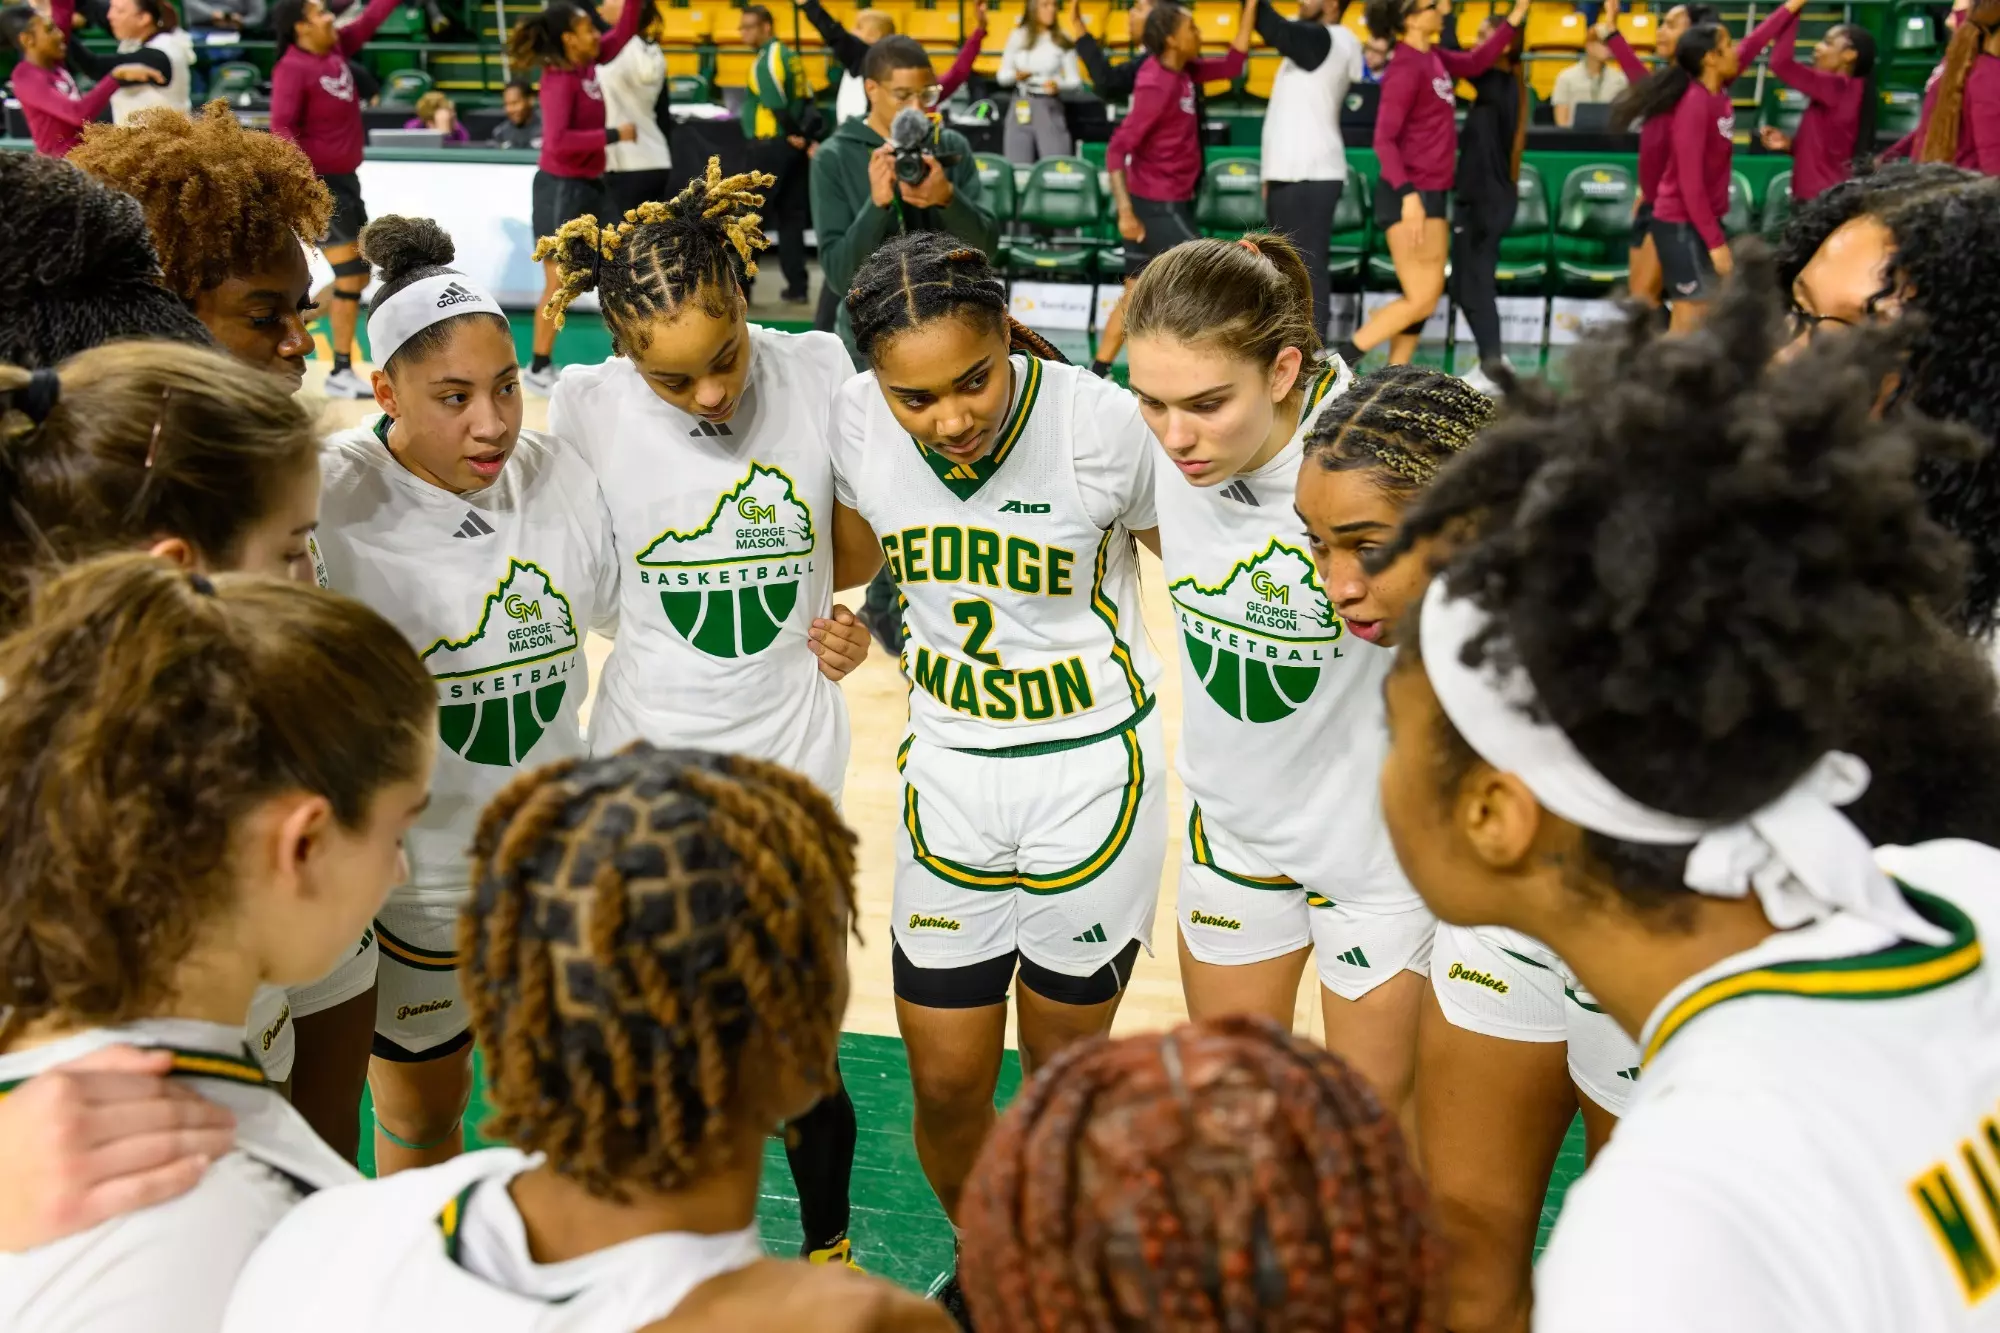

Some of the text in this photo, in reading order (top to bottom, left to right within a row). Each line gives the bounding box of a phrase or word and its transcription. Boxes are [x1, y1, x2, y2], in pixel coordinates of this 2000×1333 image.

[437, 293, 482, 308] adidas
[737, 496, 777, 524] GM
[998, 500, 1051, 514] A10
[735, 526, 786, 538] GEORGE
[640, 561, 814, 586] BASKETBALL
[881, 524, 1076, 597] GEORGE
[1251, 570, 1290, 605] GM
[504, 594, 543, 623] GM
[1246, 601, 1298, 620] GEORGE
[507, 622, 552, 640] GEORGE
[952, 597, 1003, 669] 2
[1172, 600, 1344, 661] ASKETBALL
[438, 656, 576, 699] SKETBALL
[914, 645, 1095, 721] MASON
[909, 913, 961, 931] Patriots
[1191, 910, 1241, 930] Patriots
[1448, 963, 1509, 994] Patriots
[396, 999, 454, 1020] Patriots
